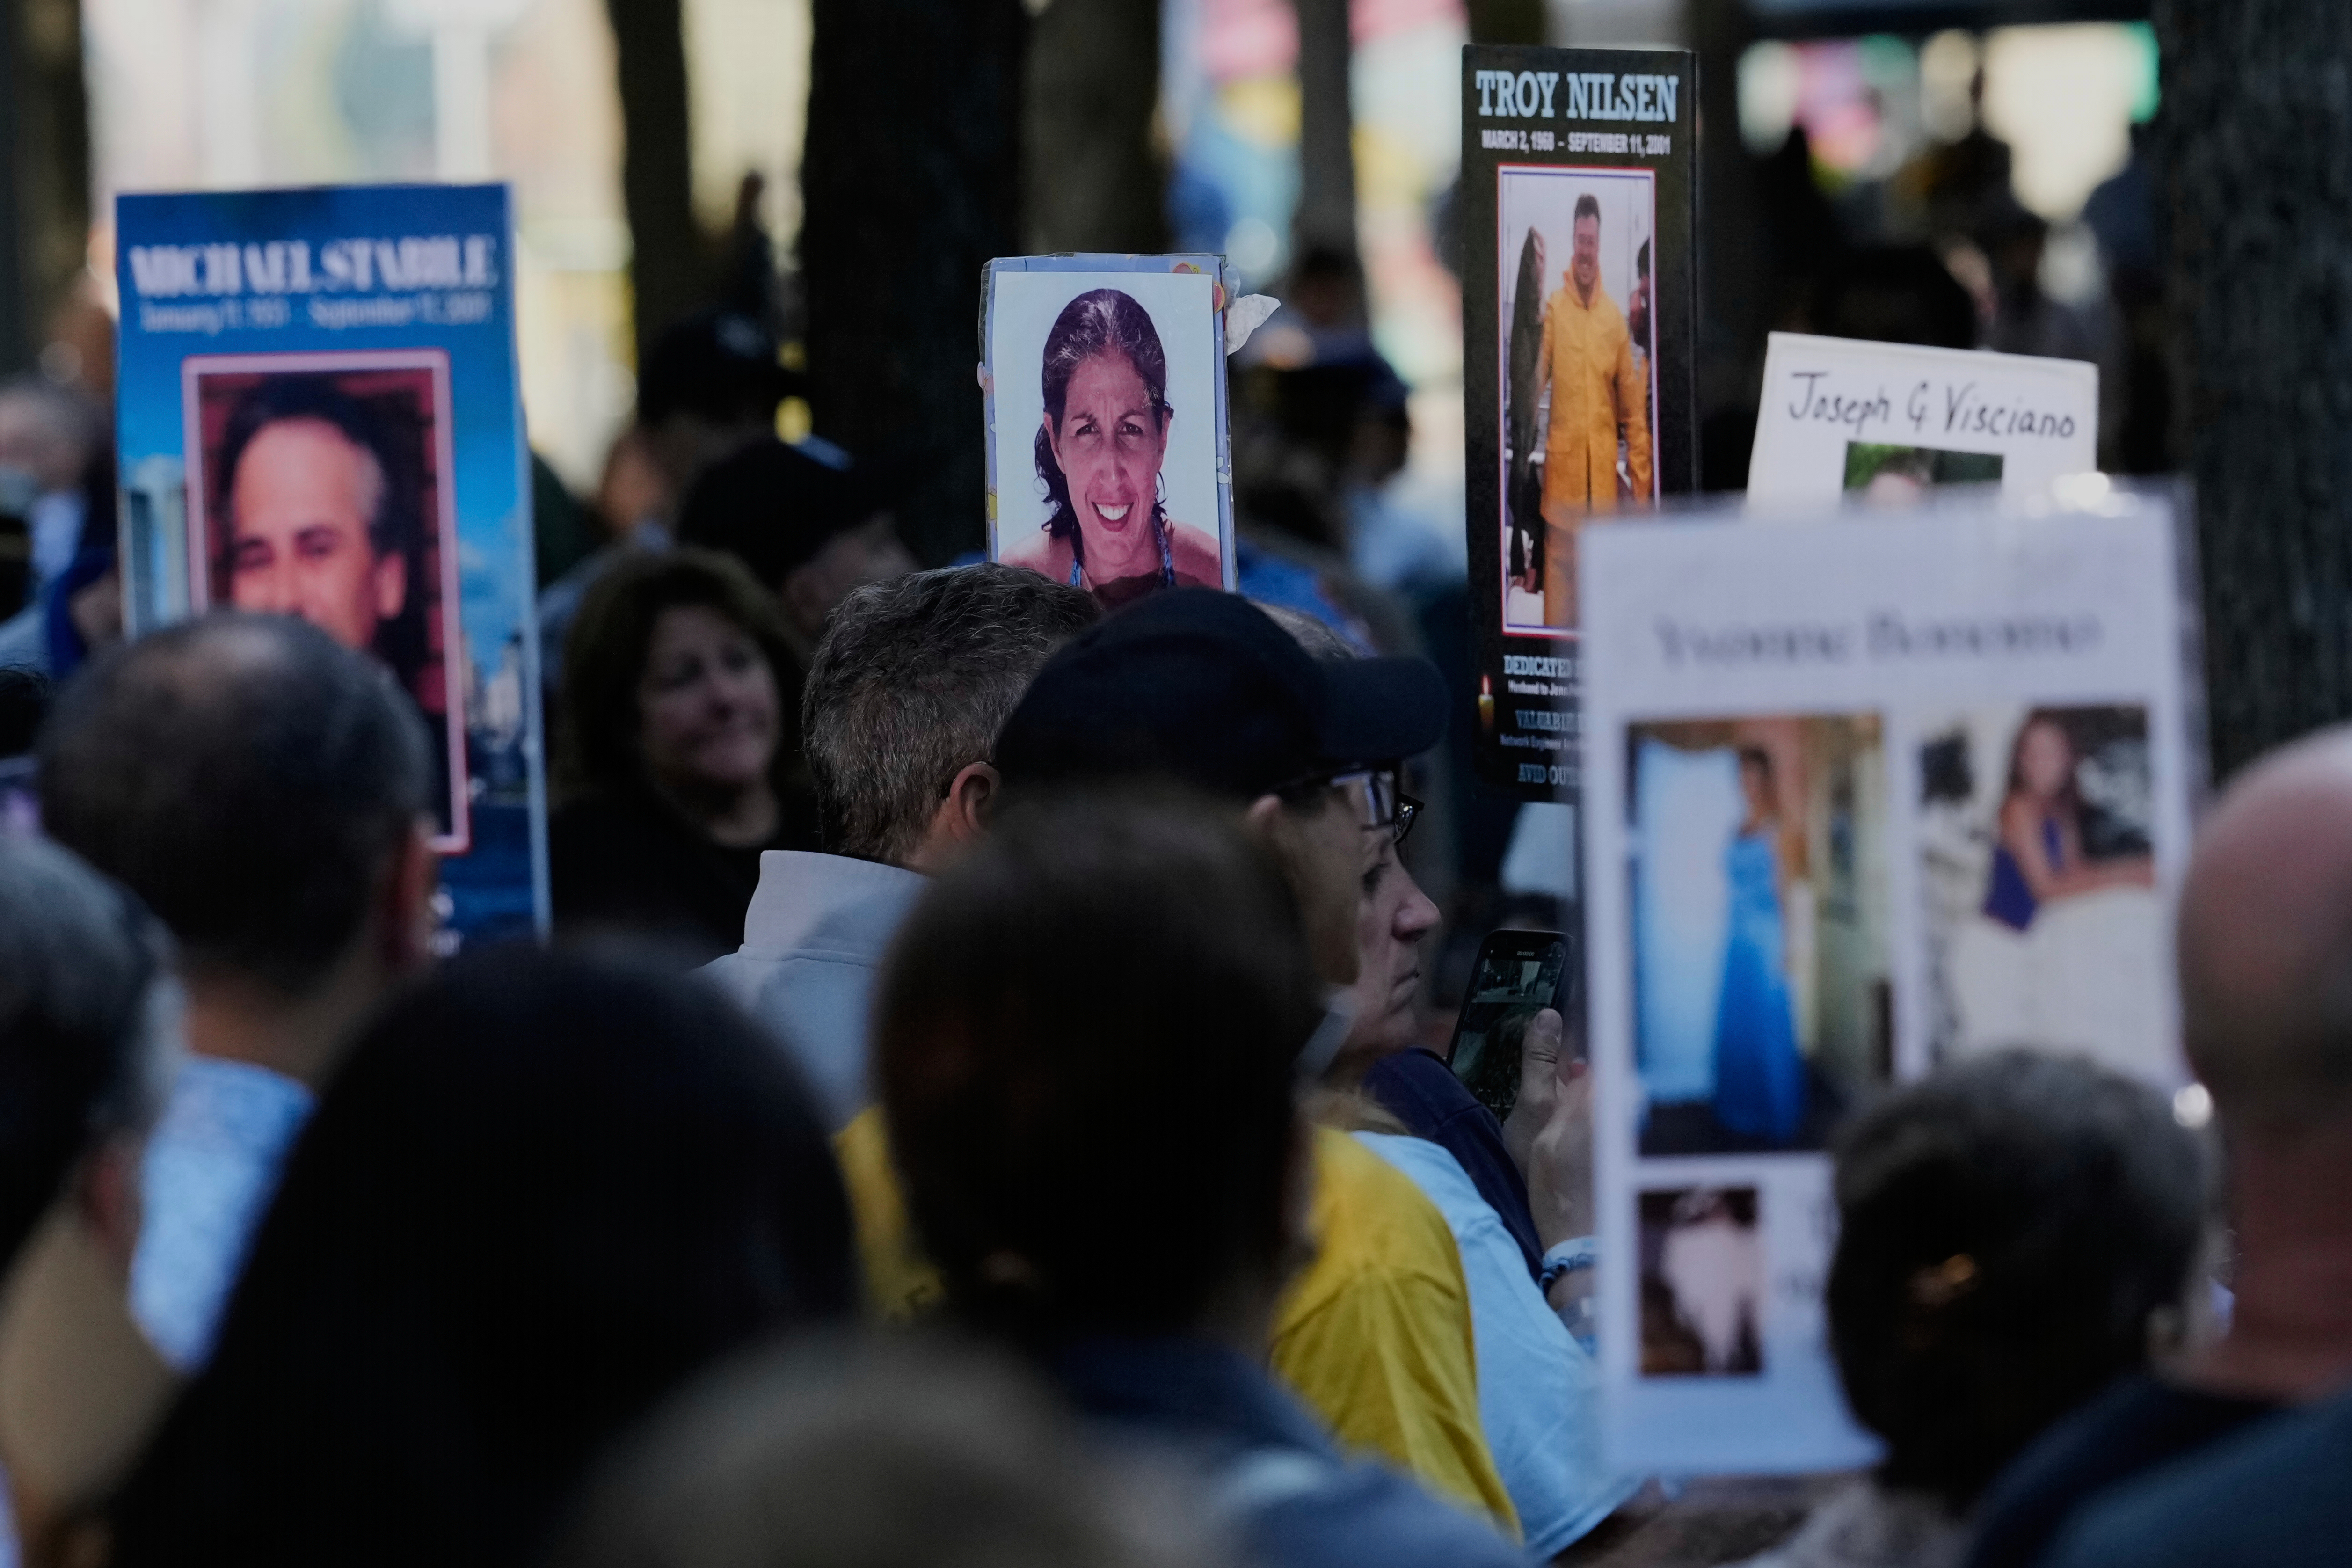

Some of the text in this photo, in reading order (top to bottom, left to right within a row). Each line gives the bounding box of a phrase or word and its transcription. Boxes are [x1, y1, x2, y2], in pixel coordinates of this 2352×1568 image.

[1475, 70, 1679, 122] TROY NILSEN
[1481, 129, 1518, 150] MARCH
[1519, 130, 1529, 154] 2,
[1567, 131, 1629, 154] SEPTEMBER
[1645, 134, 1671, 155] 2001
[129, 234, 498, 298] MICHAEL STABILE
[1788, 372, 1891, 435] Joseph
[1944, 381, 2075, 438] Visciano
